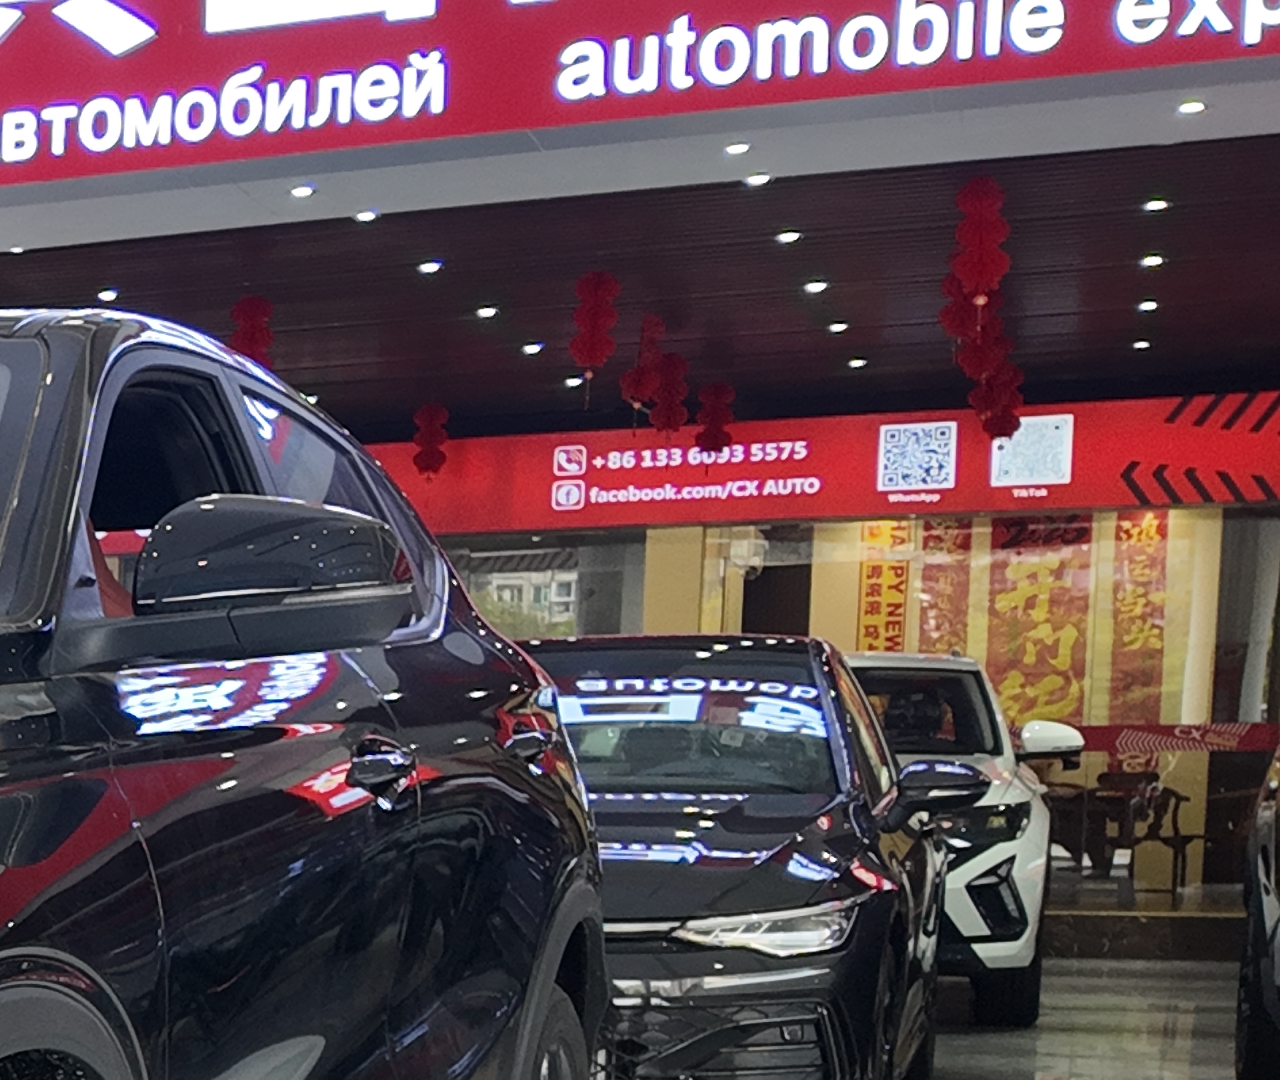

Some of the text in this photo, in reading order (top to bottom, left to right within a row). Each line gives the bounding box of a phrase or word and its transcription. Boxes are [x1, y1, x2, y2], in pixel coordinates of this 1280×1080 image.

[557, 0, 1064, 100] automobile
[592, 450, 635, 470] +86
[641, 448, 682, 468] 133
[750, 440, 808, 462] 5575
[589, 477, 821, 503] facebook.com/CX AUTO
